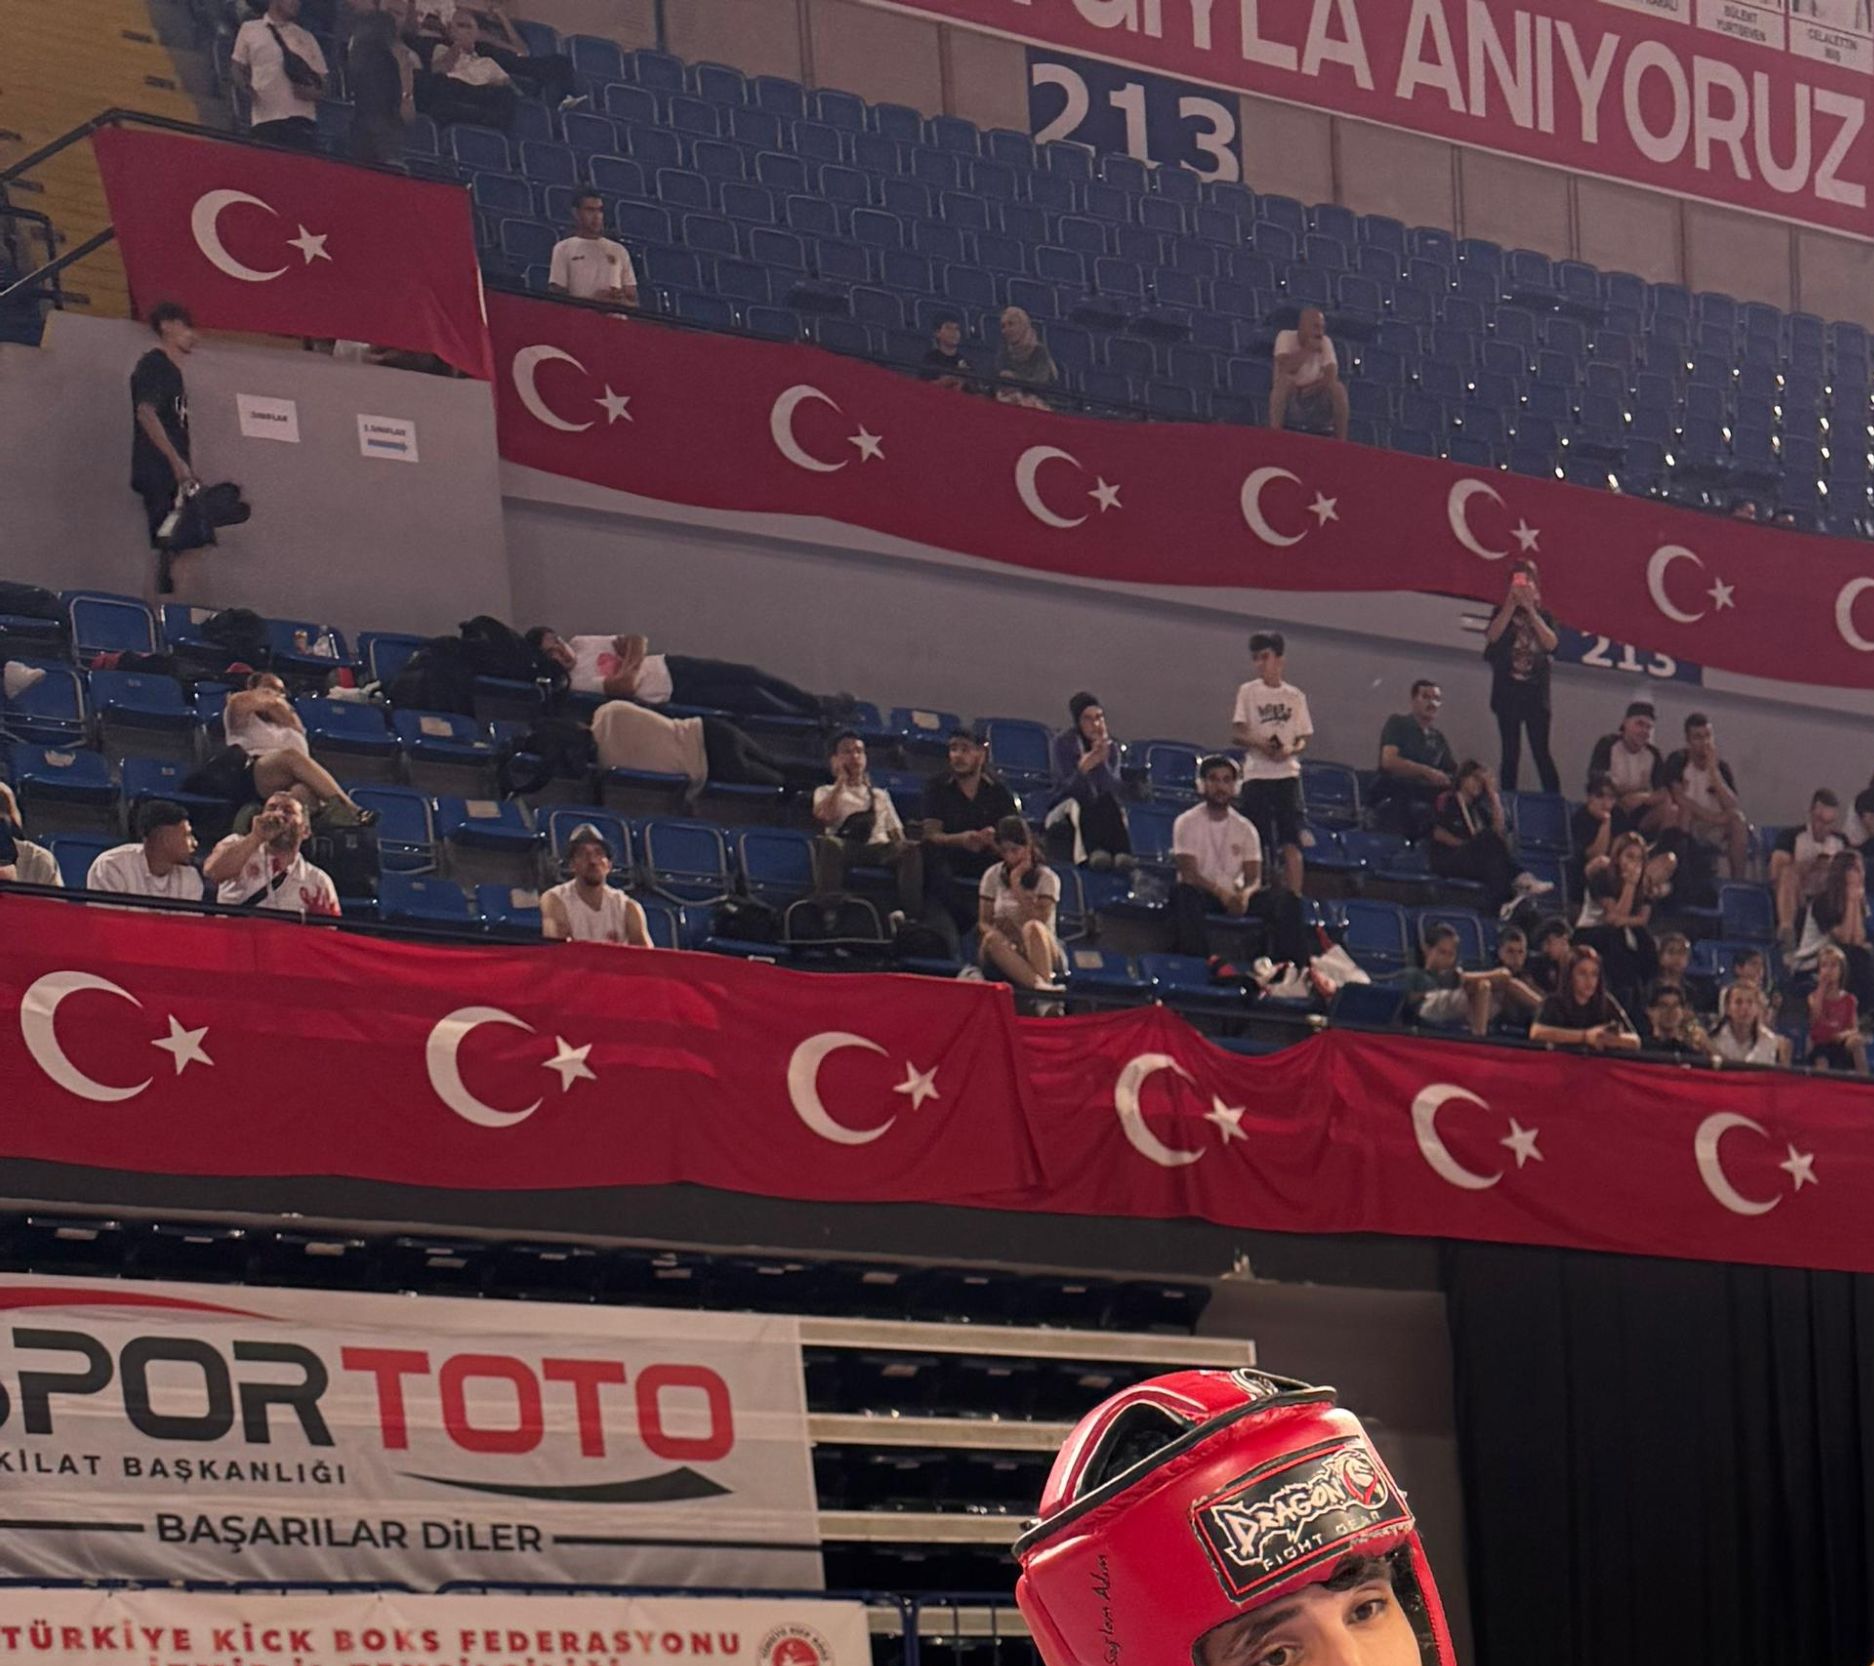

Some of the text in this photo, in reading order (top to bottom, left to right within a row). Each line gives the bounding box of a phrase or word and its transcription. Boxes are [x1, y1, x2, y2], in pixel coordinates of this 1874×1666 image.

[1031, 62, 1240, 183] 213
[1395, 0, 1867, 207] ANIYORUZ
[123, 1455, 347, 1486] BAŞKANLIĞI
[155, 1512, 408, 1549] BAŞARILAR
[1262, 1532, 1324, 1572] FIGHT
[1, 1620, 741, 1656] TÜRKİYE KİCK BOKS FEDERASYONU
